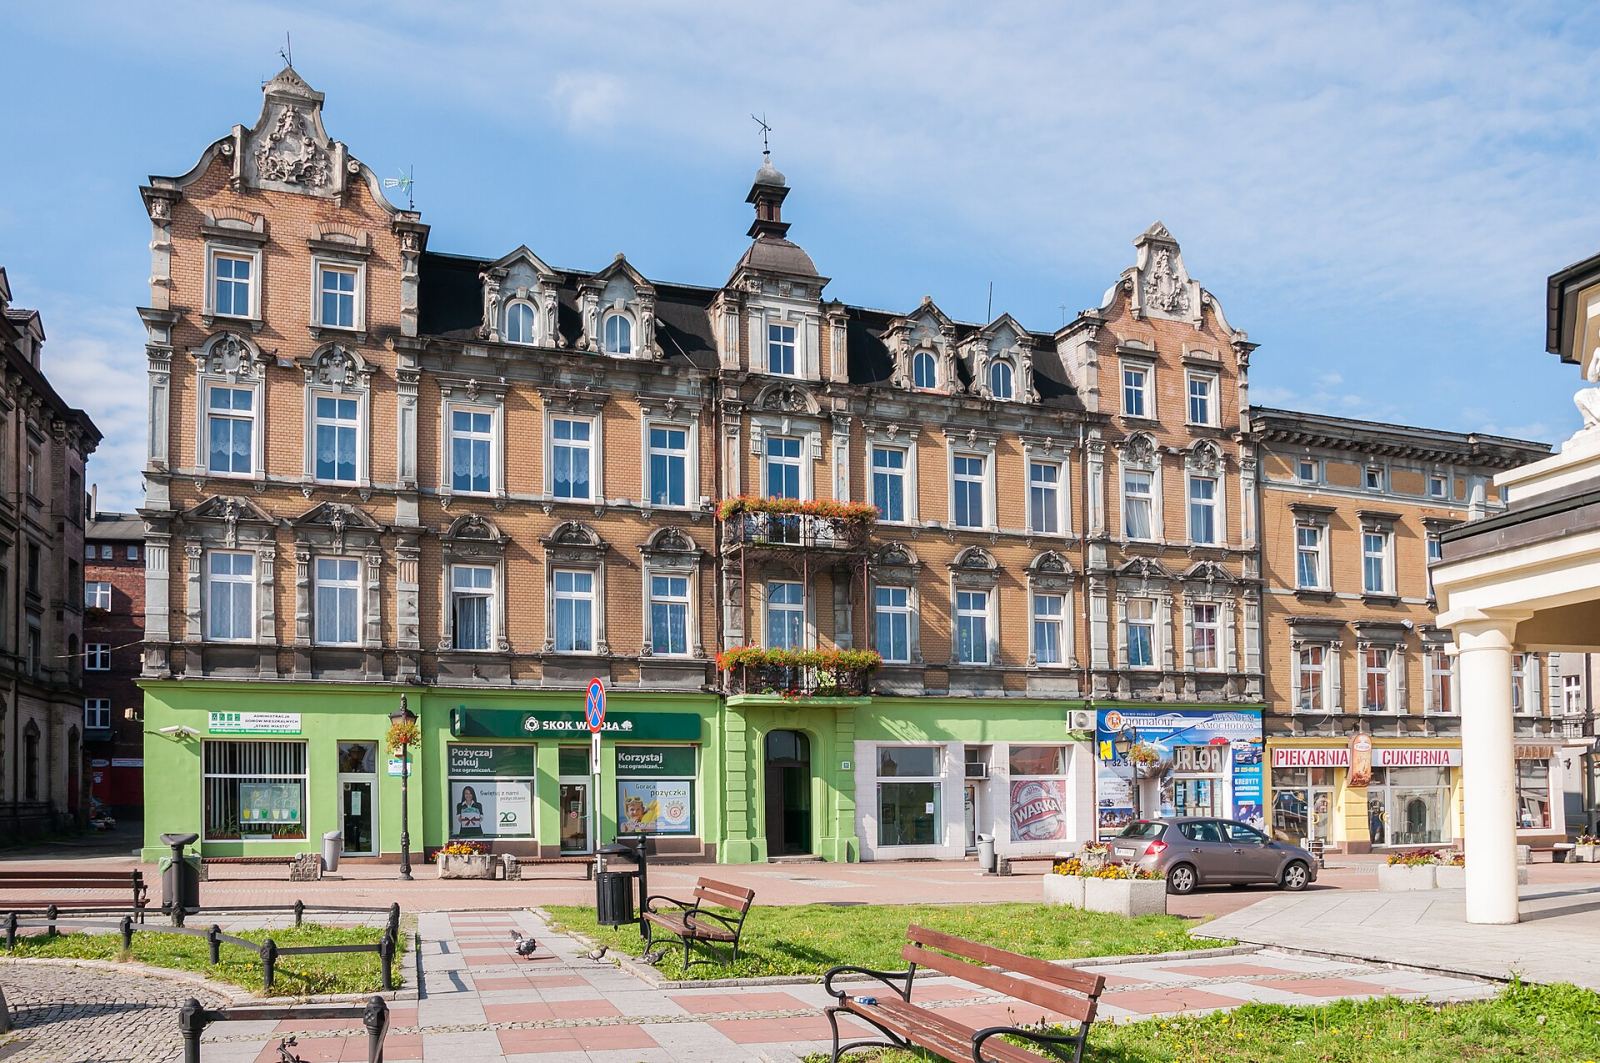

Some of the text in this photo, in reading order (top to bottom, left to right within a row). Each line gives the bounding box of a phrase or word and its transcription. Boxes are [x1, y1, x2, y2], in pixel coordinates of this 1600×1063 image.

[542, 720, 573, 730] SKOK
[451, 748, 493, 758] Pożyczaj
[618, 753, 663, 763] Korzystaj
[1276, 750, 1349, 766] PIEKARNIA
[1382, 750, 1450, 765] CUKIERNIA
[451, 758, 479, 768] Lokuj
[1014, 799, 1060, 823] WARKA
[499, 811, 517, 823] 20
